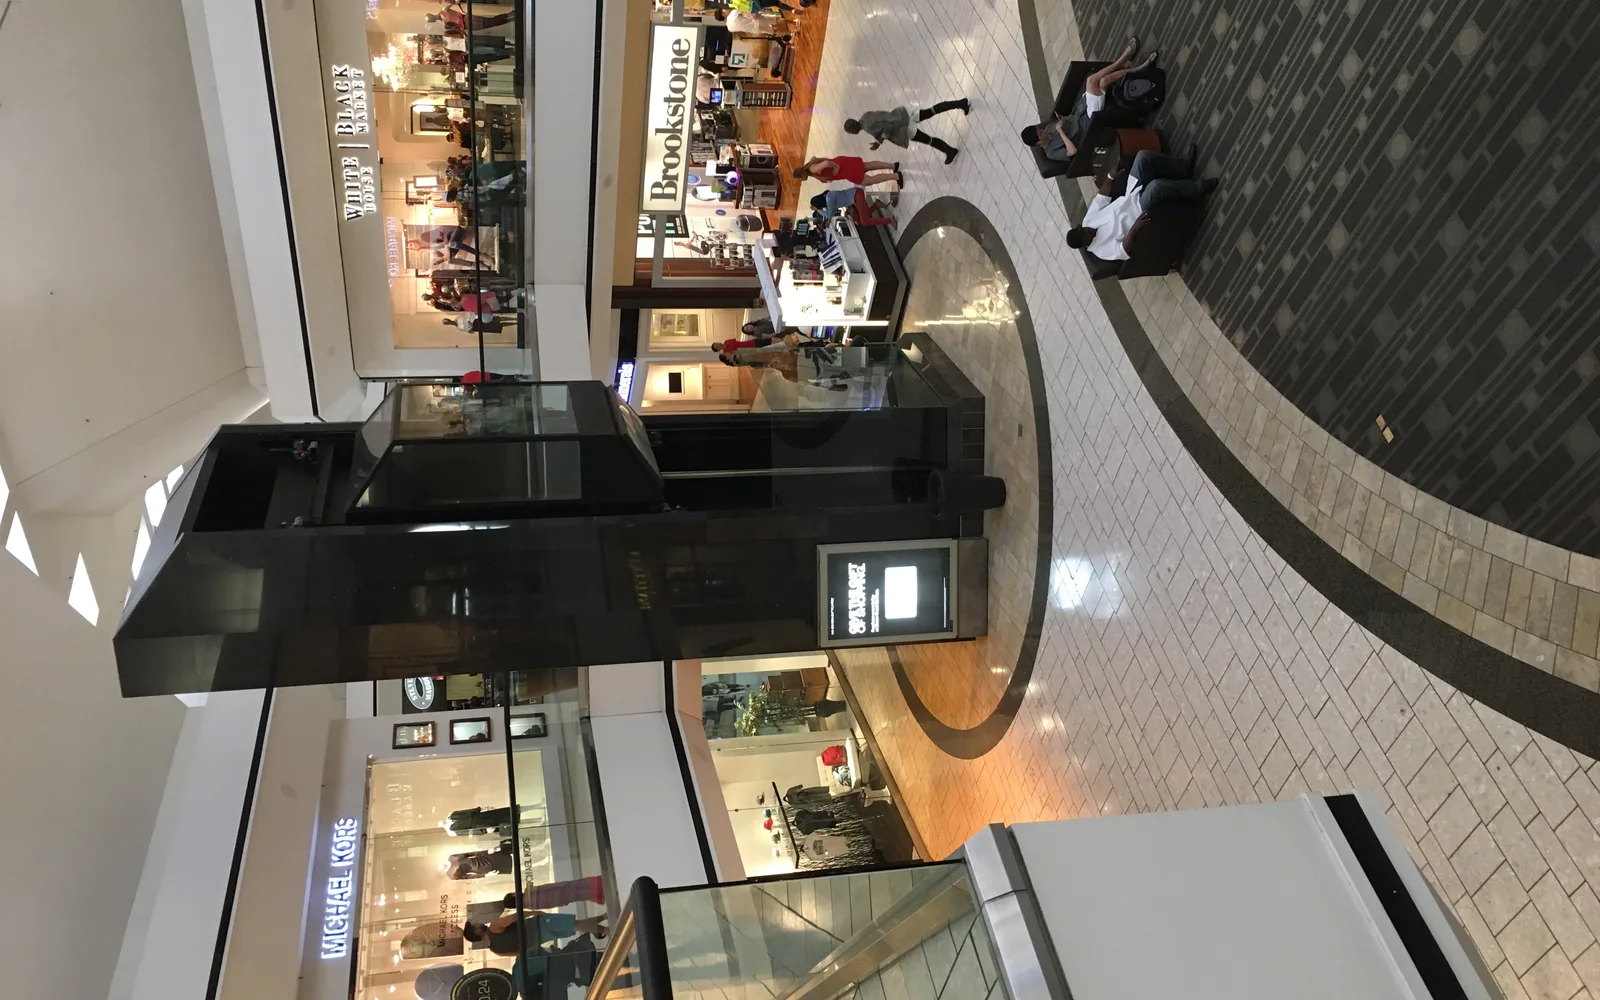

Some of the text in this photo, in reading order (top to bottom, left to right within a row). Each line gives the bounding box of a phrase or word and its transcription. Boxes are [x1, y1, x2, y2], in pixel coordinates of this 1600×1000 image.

[332, 64, 365, 221] WHITE BLACK
[352, 68, 377, 214] HOUSE MARKET
[649, 38, 692, 202] Brookstone
[406, 678, 418, 701] STEVE
[320, 817, 358, 959] MICHAEL KORS
[439, 894, 448, 913] KORS
